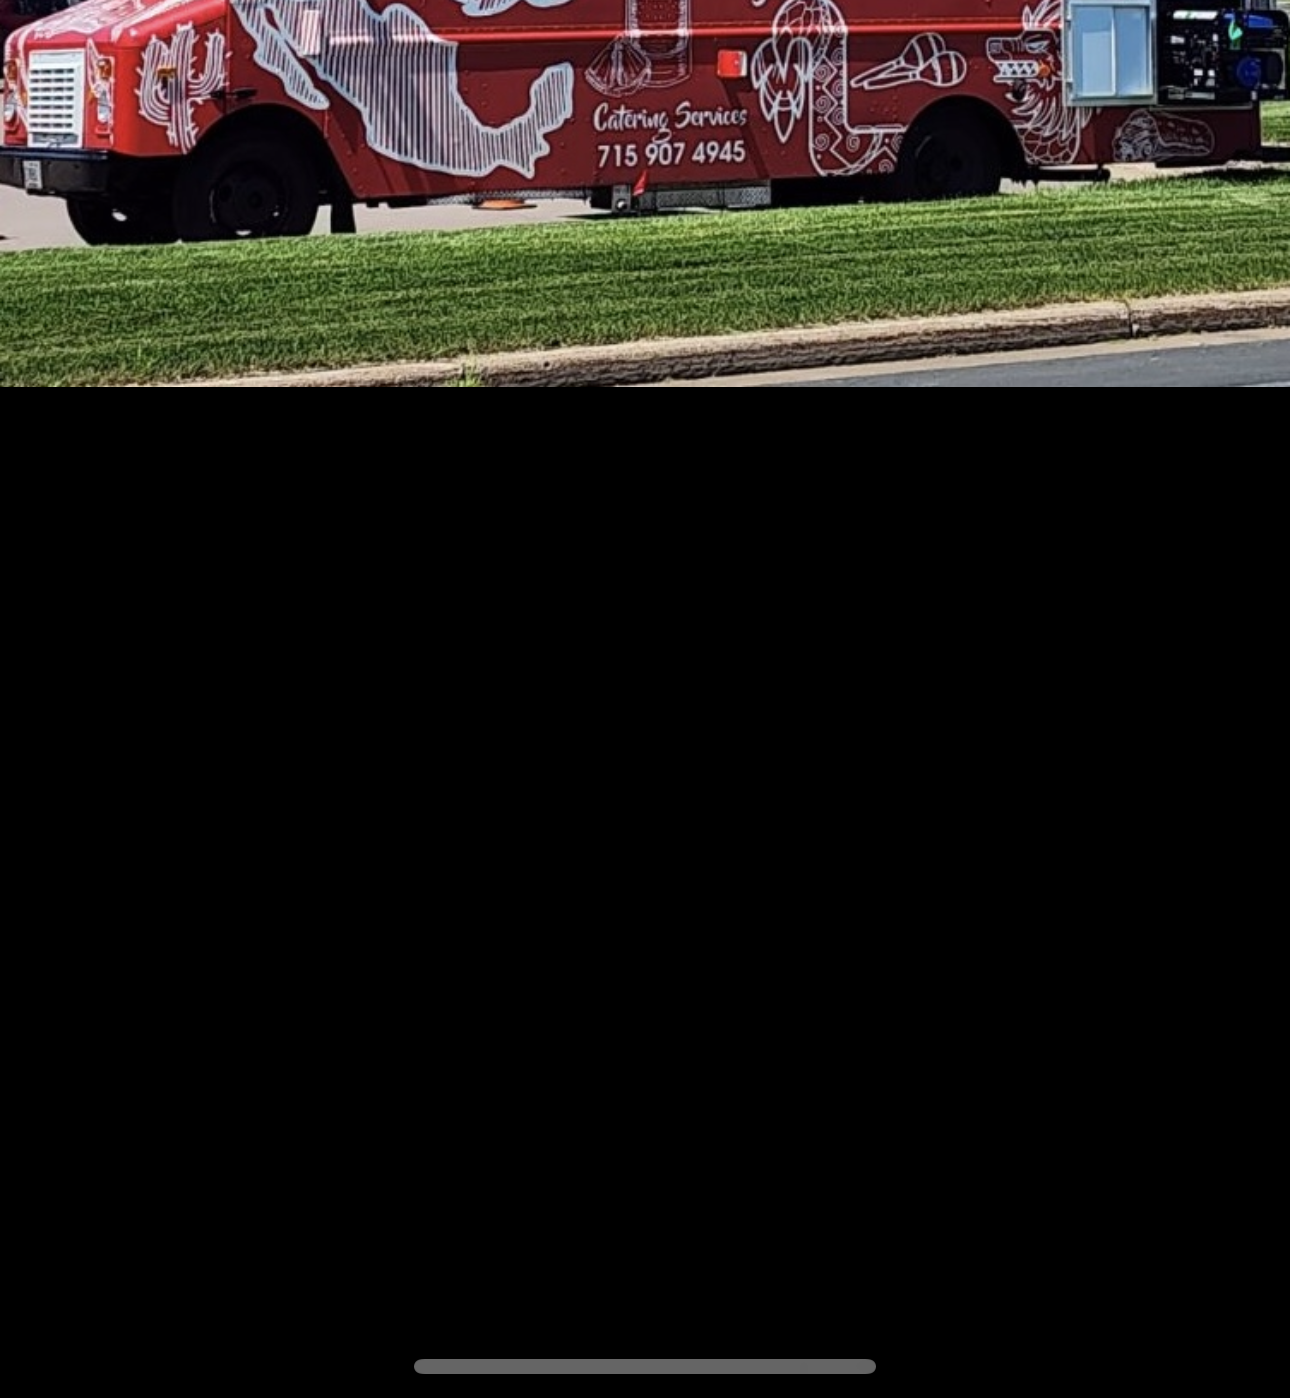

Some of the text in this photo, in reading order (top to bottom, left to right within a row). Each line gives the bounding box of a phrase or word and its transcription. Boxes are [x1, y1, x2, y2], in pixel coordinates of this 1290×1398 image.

[593, 100, 748, 144] Catering Services
[597, 139, 746, 169] 715 907 4945
